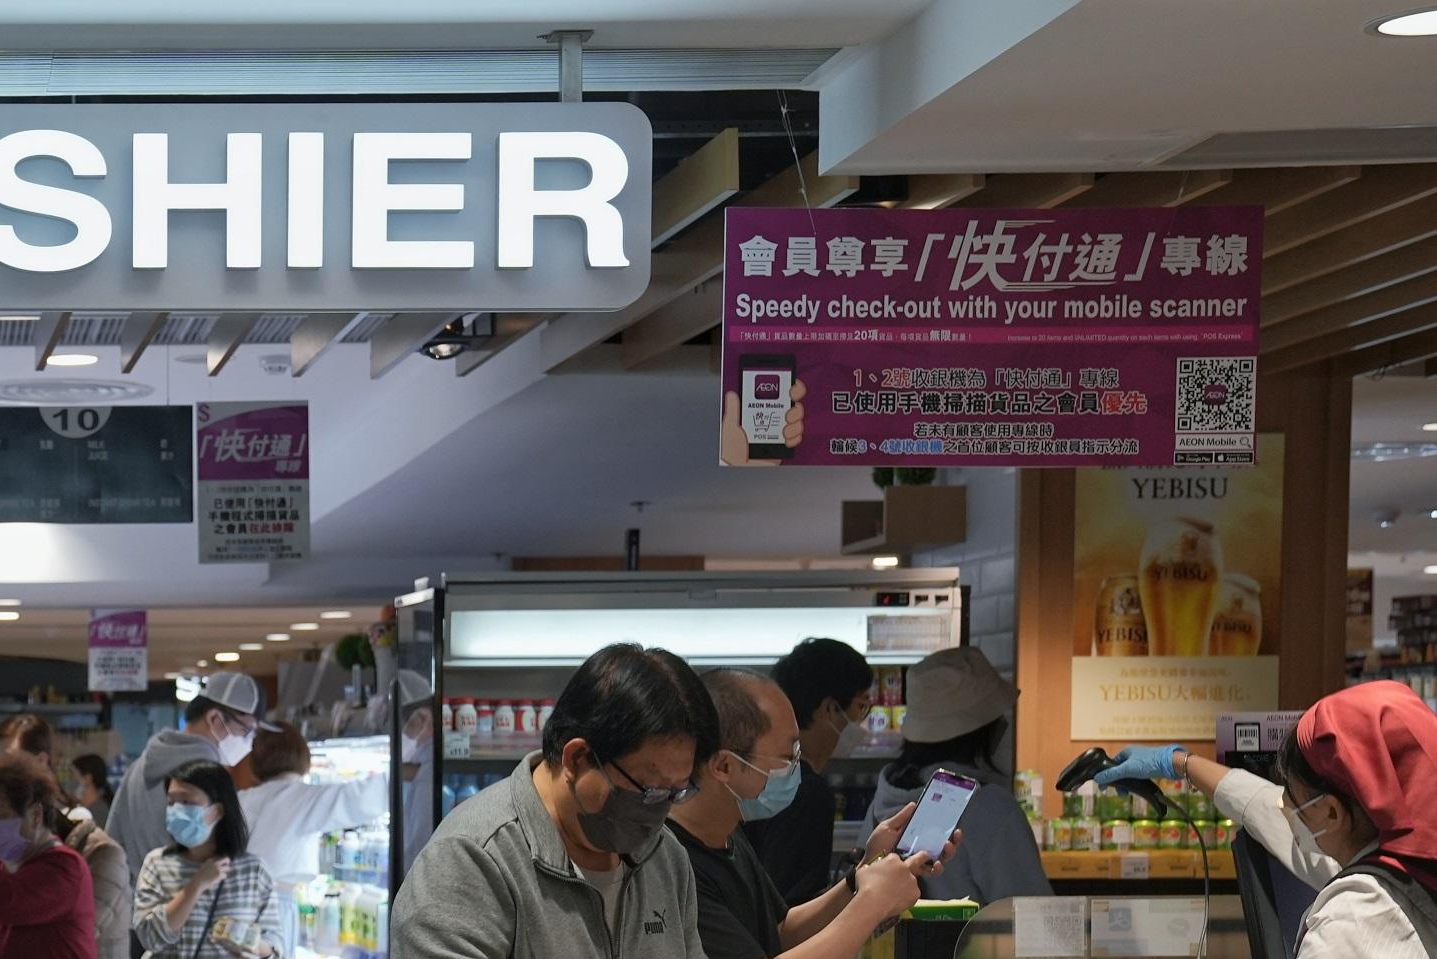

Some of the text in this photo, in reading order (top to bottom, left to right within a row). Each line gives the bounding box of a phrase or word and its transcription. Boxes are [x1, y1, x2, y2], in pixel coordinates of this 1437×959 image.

[735, 292, 1247, 325] Speedy check-out with your mobile scanner
[832, 391, 1148, 414] 已使用手機掃描貨品之會員優先
[53, 409, 99, 430] 10
[199, 428, 307, 463] 「快付通」
[1179, 438, 1237, 446] AEON Mobile
[1132, 477, 1228, 500] YEBISU
[1097, 627, 1147, 646] YEBIS
[644, 921, 664, 934] PUMA
